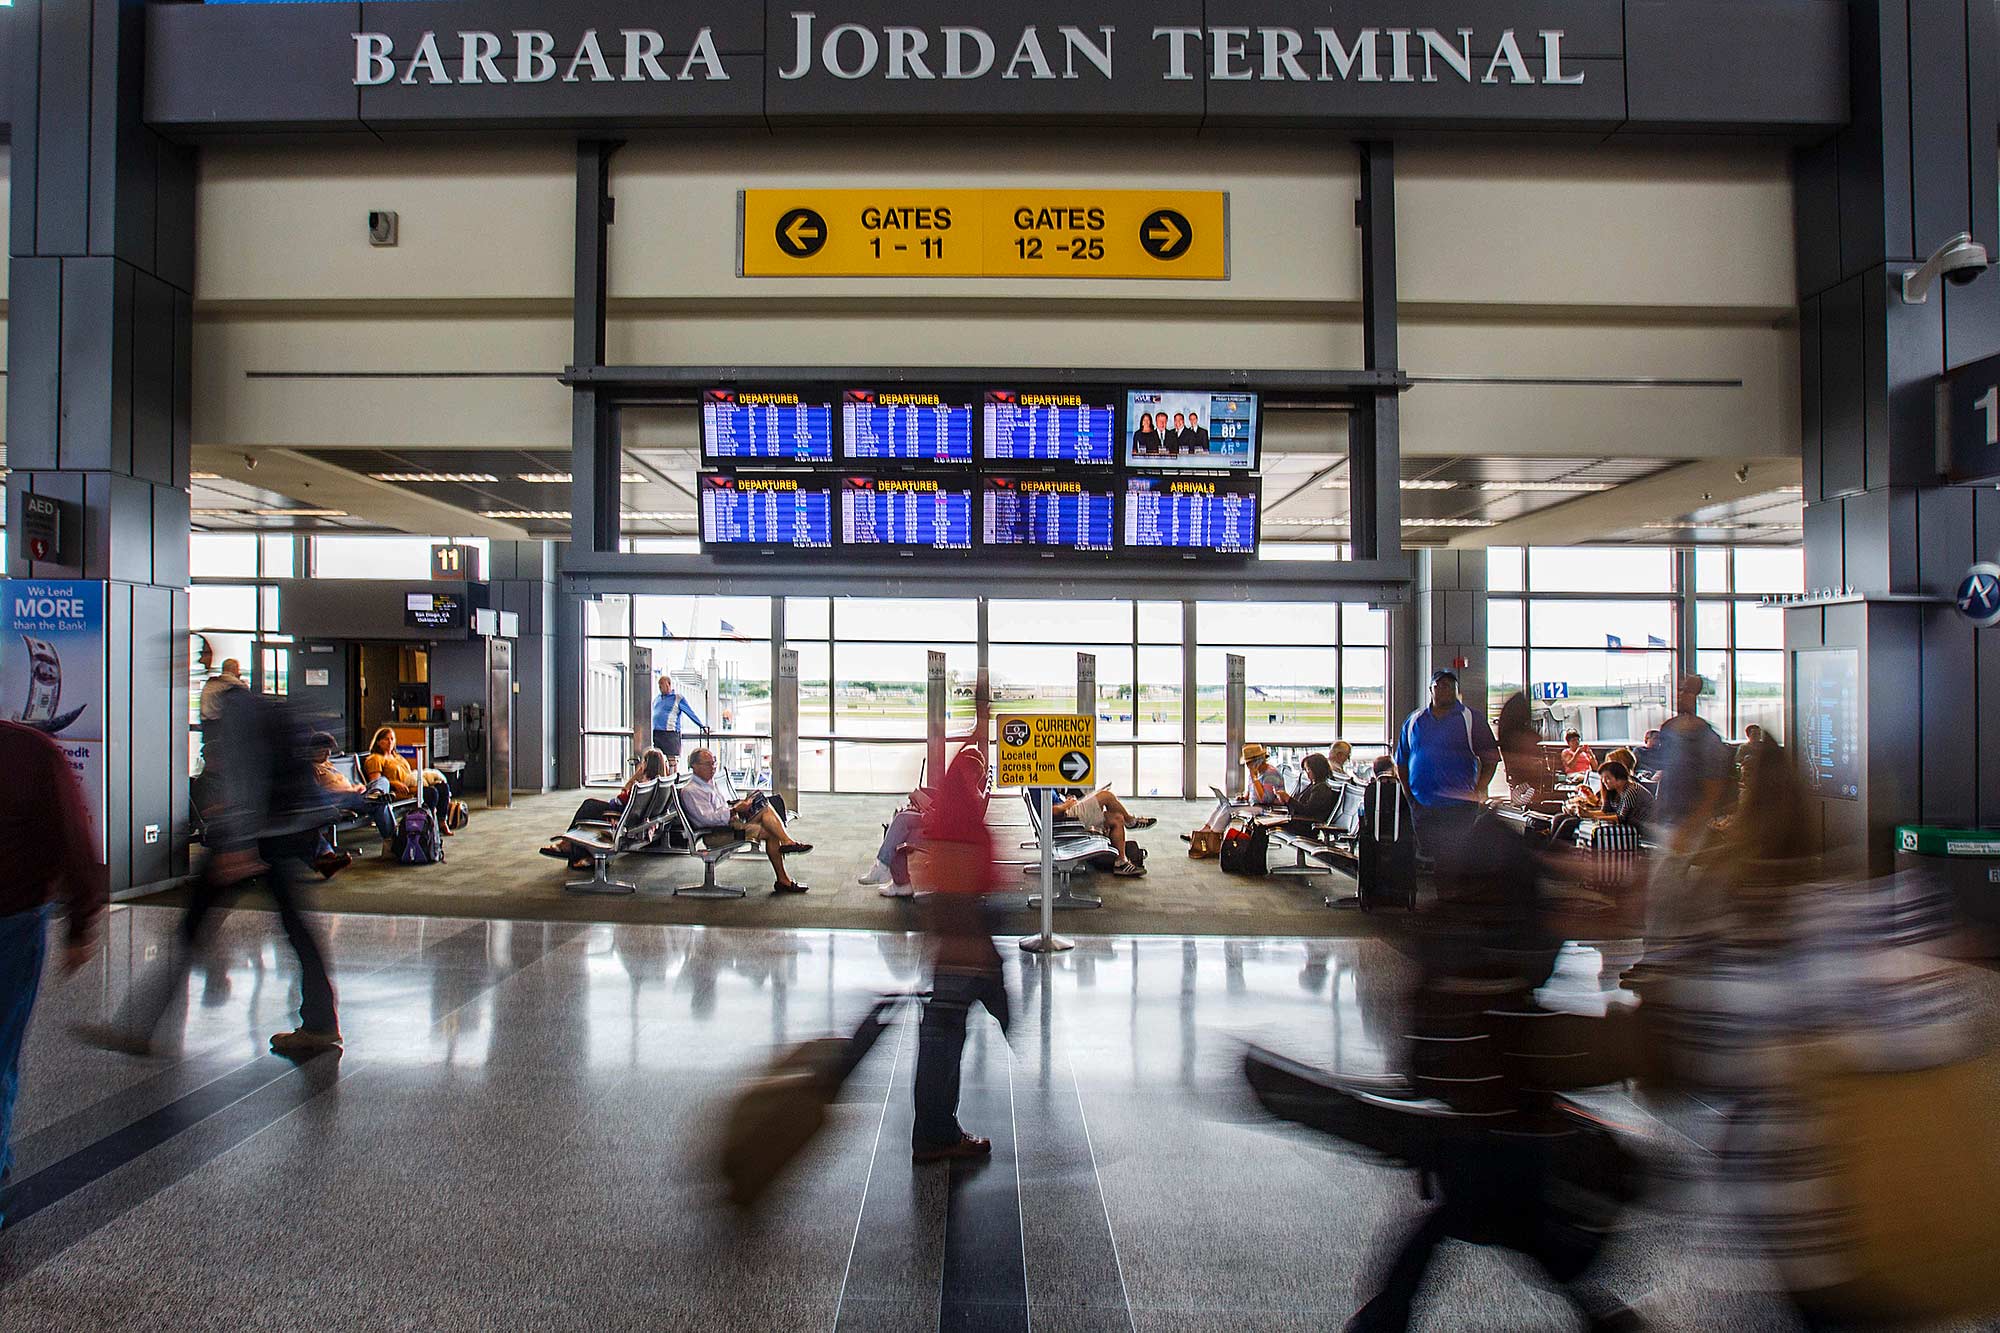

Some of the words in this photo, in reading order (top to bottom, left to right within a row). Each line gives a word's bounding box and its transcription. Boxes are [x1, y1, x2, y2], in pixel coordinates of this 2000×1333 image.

[351, 28, 730, 85] BARBARA
[779, 11, 1115, 79] JORDAN
[1152, 26, 1585, 84] TERMINAL
[861, 208, 952, 230] GATES
[1014, 208, 1105, 230] GATES
[870, 238, 881, 259] 1
[920, 238, 943, 259] 11
[739, 393, 799, 404] DEPARTURES
[879, 394, 940, 405] DEPARTURES
[1021, 394, 1082, 406] DEPARTURES
[738, 480, 798, 491] DEPARTURES
[878, 480, 939, 491] DEPARTURES
[1020, 481, 1082, 492] DEPARTURES
[1170, 482, 1215, 493] ARRIVALS
[28, 499, 54, 514] AED
[437, 548, 459, 570] 11
[28, 586, 45, 597] We
[47, 586, 73, 597] Lend
[1761, 585, 1855, 604] DIRECTORY
[15, 598, 85, 618] MORE
[14, 621, 37, 630] than
[39, 621, 55, 630] the
[58, 621, 87, 631] Bank!
[1547, 683, 1564, 698] 12
[1036, 719, 1091, 732] CURRENCY
[1034, 735, 1091, 748] EXCHANGE
[1001, 750, 1038, 760] Located
[1002, 764, 1032, 772] across
[1035, 761, 1056, 772] from
[1002, 773, 1025, 783] Gate
[1028, 773, 1039, 783] 14
